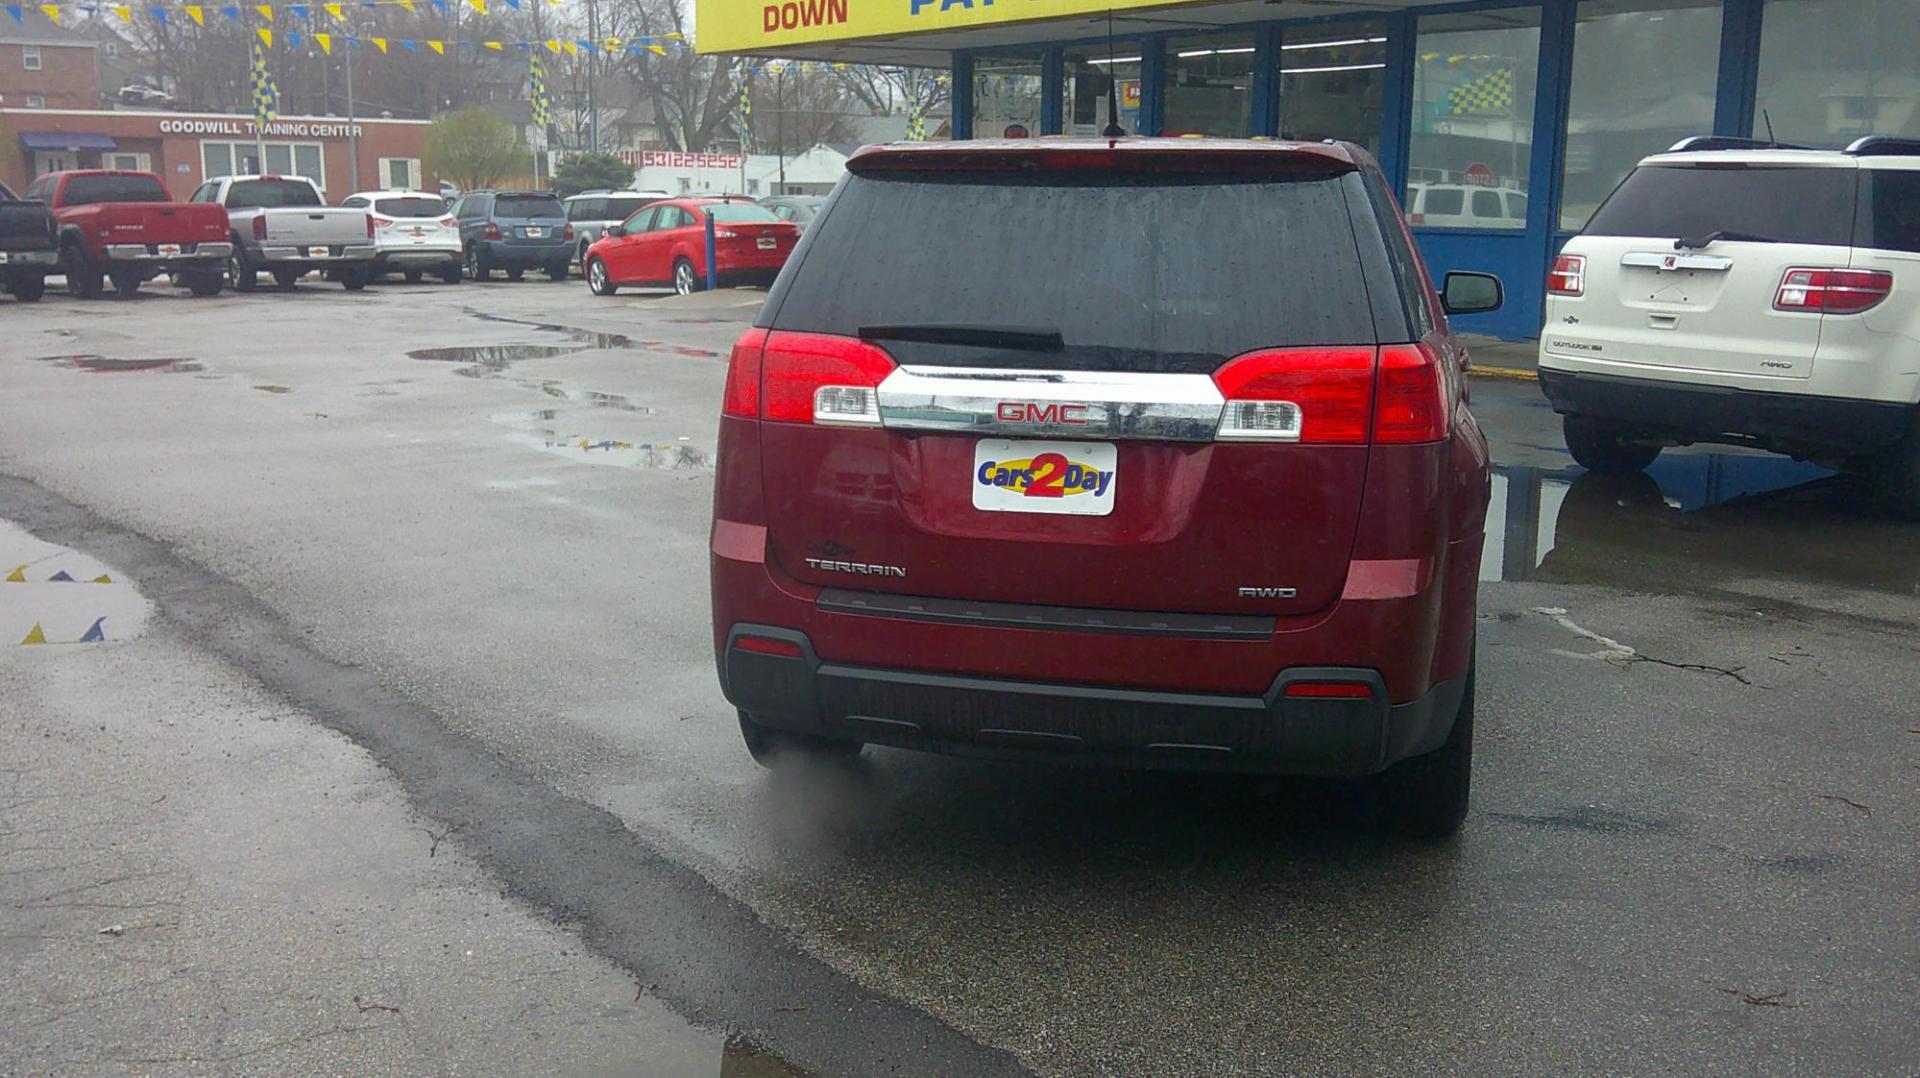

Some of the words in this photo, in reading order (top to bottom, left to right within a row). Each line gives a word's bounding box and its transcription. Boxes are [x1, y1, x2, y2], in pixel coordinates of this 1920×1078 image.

[764, 0, 848, 32] DOWN
[160, 120, 241, 134] GOODWILL
[997, 401, 1087, 425] GMC
[805, 558, 906, 577] TERRAIN
[1239, 587, 1297, 598] AWD
